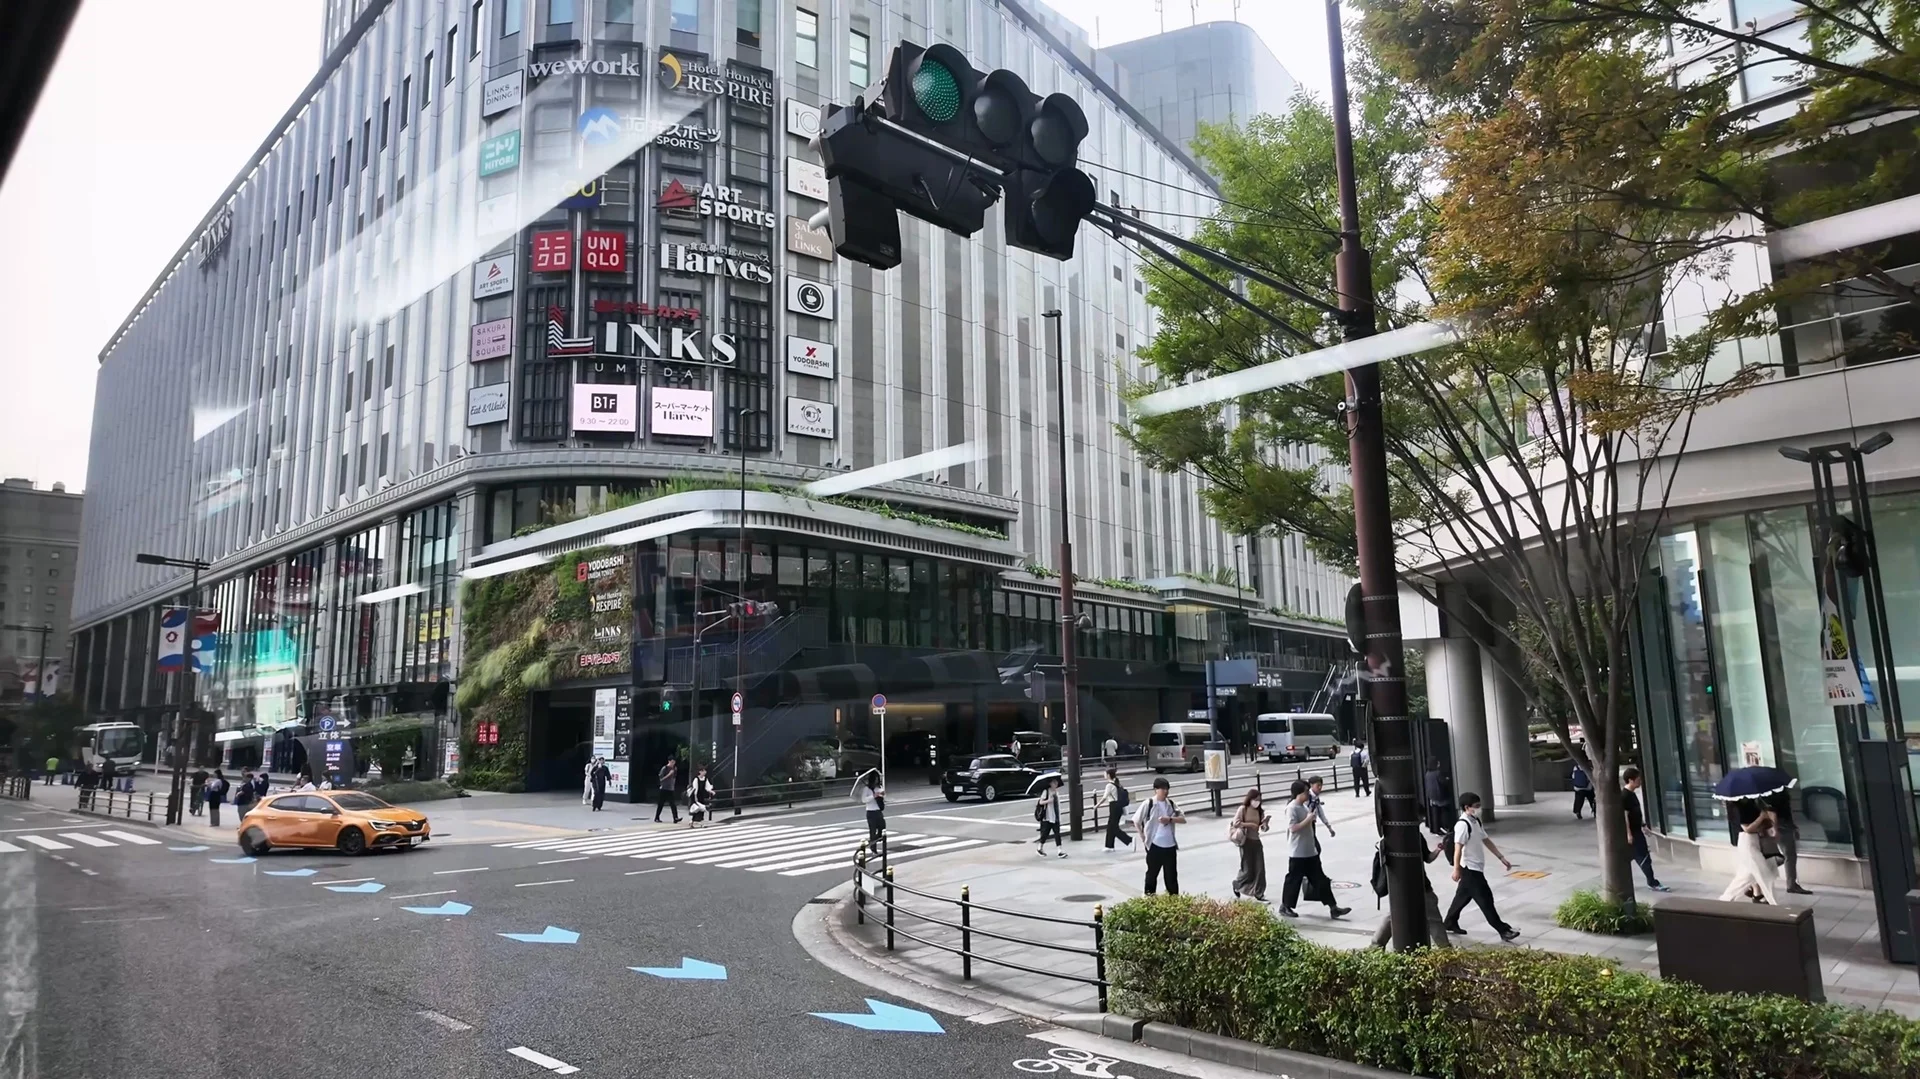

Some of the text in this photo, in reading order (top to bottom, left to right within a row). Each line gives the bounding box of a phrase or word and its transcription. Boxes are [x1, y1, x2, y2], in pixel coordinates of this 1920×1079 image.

[529, 53, 640, 78] wework
[688, 61, 772, 89] Hotel Hankyu
[486, 84, 510, 98] LINKS
[486, 91, 512, 105] DINING
[688, 74, 772, 107] RESPIRE
[484, 136, 515, 160] ニトリ
[656, 135, 700, 150] SPORTS
[484, 154, 515, 170] NITORI
[701, 183, 742, 204] ART
[700, 199, 776, 228] SPORTS
[538, 236, 566, 251] ユニ
[587, 236, 617, 250] UNI
[794, 240, 822, 254] LINKS
[537, 252, 566, 267] クロ
[587, 252, 620, 268] QLO
[661, 242, 772, 284] Harves
[476, 323, 506, 336] SAKURA
[548, 304, 736, 364] LINKS
[476, 337, 491, 346] BUS
[476, 344, 506, 357] SQUARE
[793, 356, 830, 368] YODOBASHI
[594, 363, 693, 379] UMEDA
[471, 404, 481, 415] Eat
[487, 399, 507, 411] Walk
[594, 396, 616, 410] B1F
[655, 402, 711, 412] スーパーマーケット
[663, 410, 703, 422] Harves
[588, 555, 624, 571] YODOBASHI
[596, 599, 621, 612] RESPIRE
[595, 625, 621, 637] LINKS
